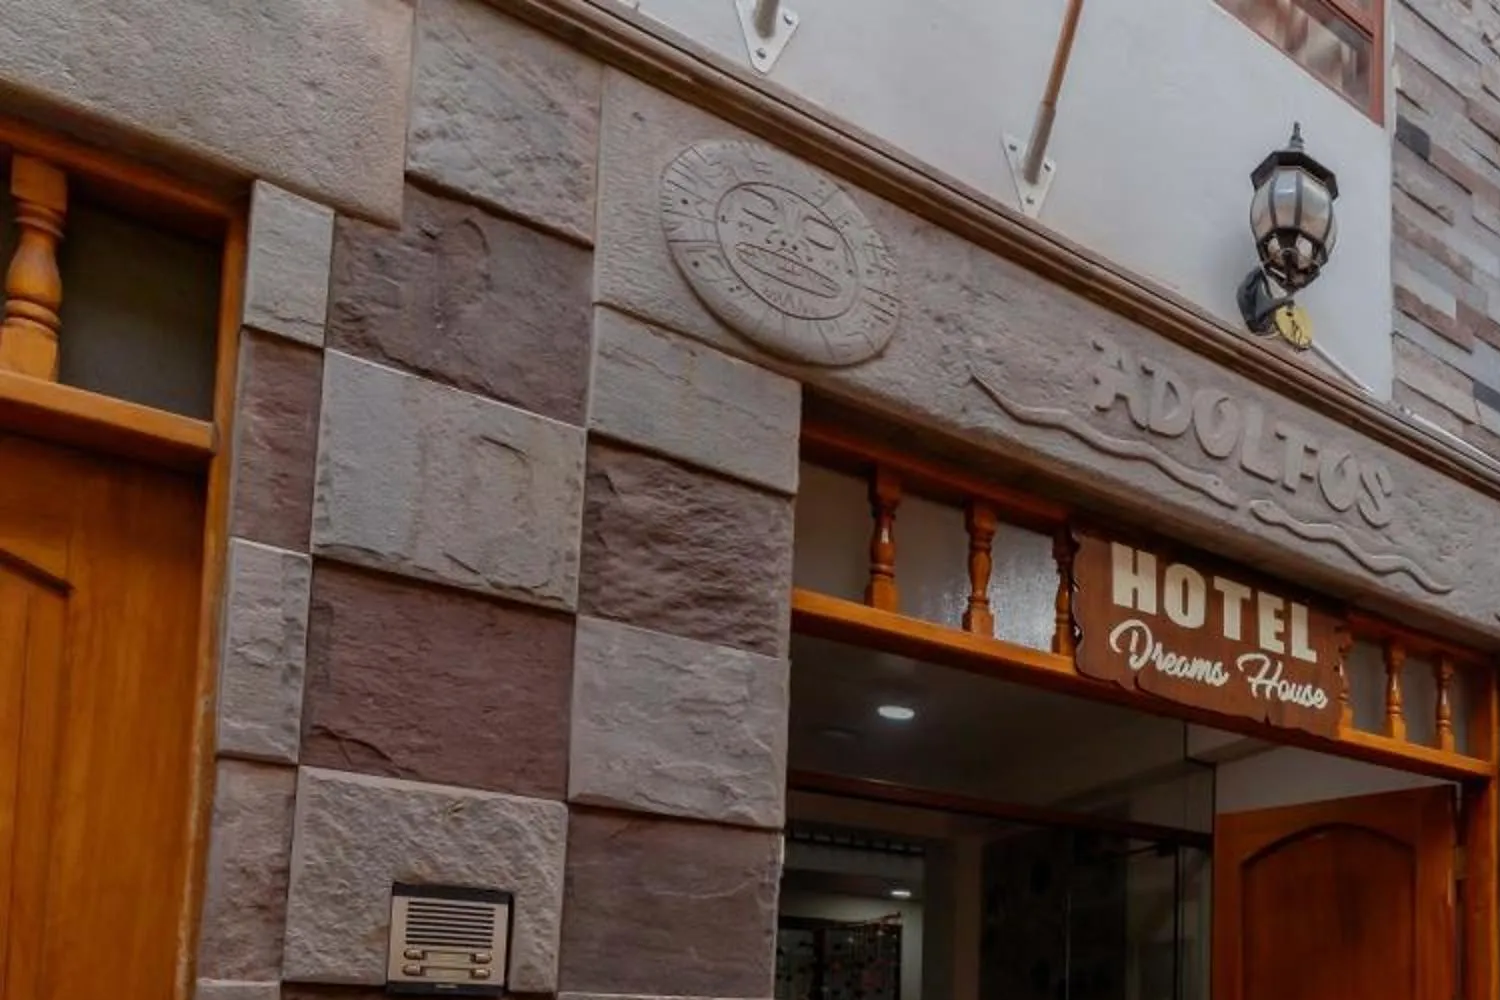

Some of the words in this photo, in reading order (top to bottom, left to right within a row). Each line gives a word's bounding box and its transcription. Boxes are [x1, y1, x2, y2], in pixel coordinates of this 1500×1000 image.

[1110, 541, 1318, 664] HOTEL
[1109, 618, 1230, 687] Dreams
[1237, 652, 1329, 710] House
